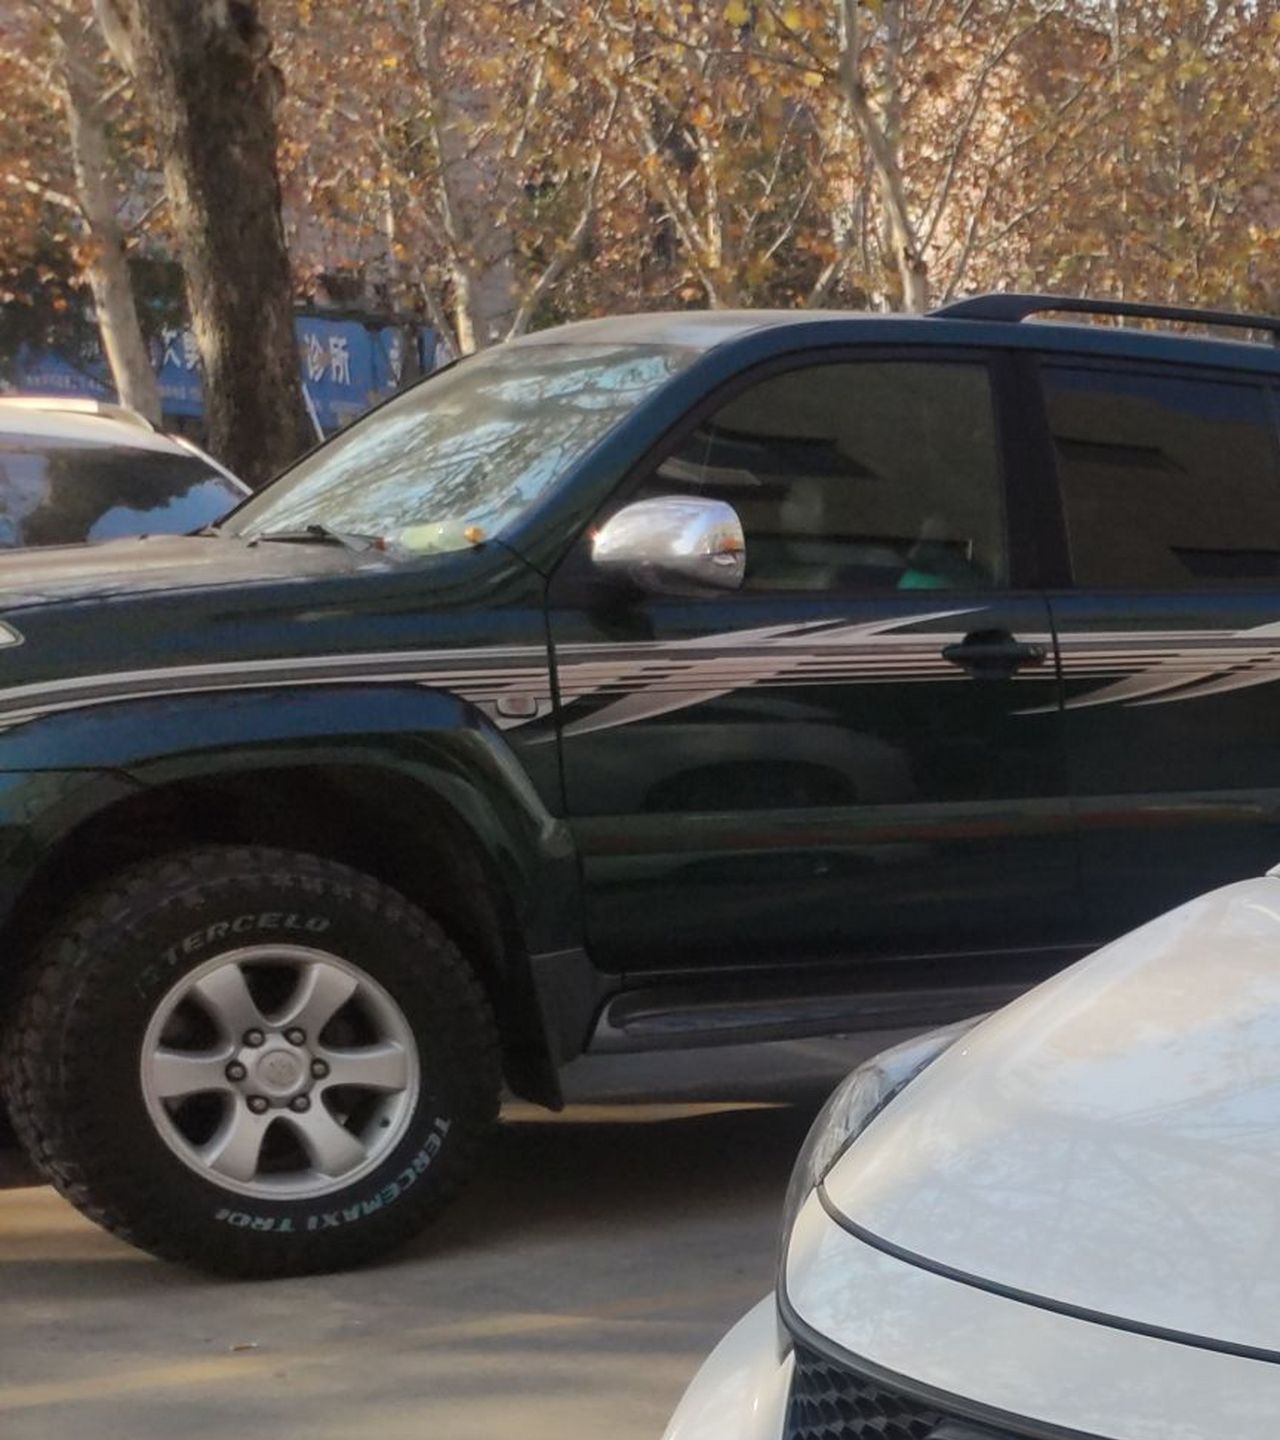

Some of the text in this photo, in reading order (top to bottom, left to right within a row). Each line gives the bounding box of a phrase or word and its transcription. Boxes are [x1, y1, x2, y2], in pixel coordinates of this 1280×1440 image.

[304, 333, 349, 385] 诊所
[163, 912, 331, 966] TERCELO
[307, 1116, 451, 1231] TERCEMAXI
